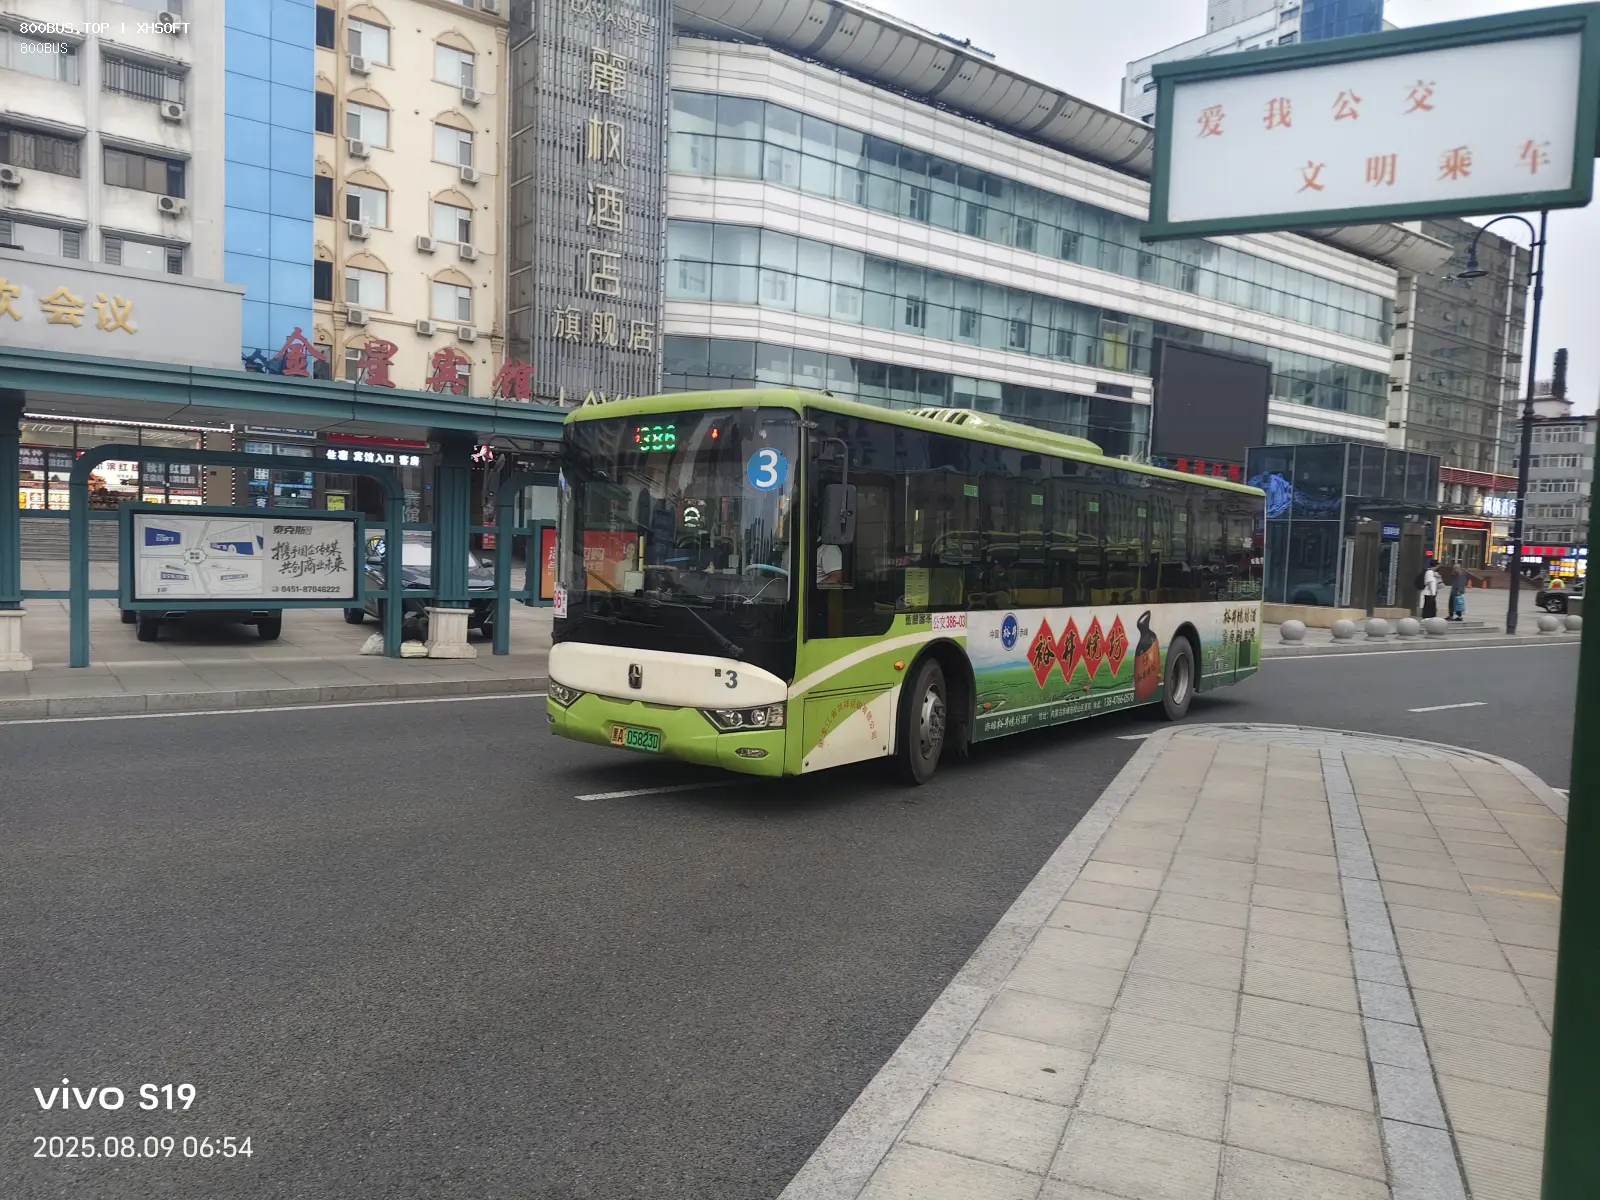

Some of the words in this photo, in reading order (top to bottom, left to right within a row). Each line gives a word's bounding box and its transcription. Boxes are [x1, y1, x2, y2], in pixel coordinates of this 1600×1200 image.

[1196, 78, 1437, 138] 爱我公交
[1295, 139, 1551, 194] 文明乘车
[552, 303, 655, 352] 旗舰店
[353, 451, 395, 464] 宾馆入口
[756, 449, 778, 488] 3
[725, 669, 738, 689] 3
